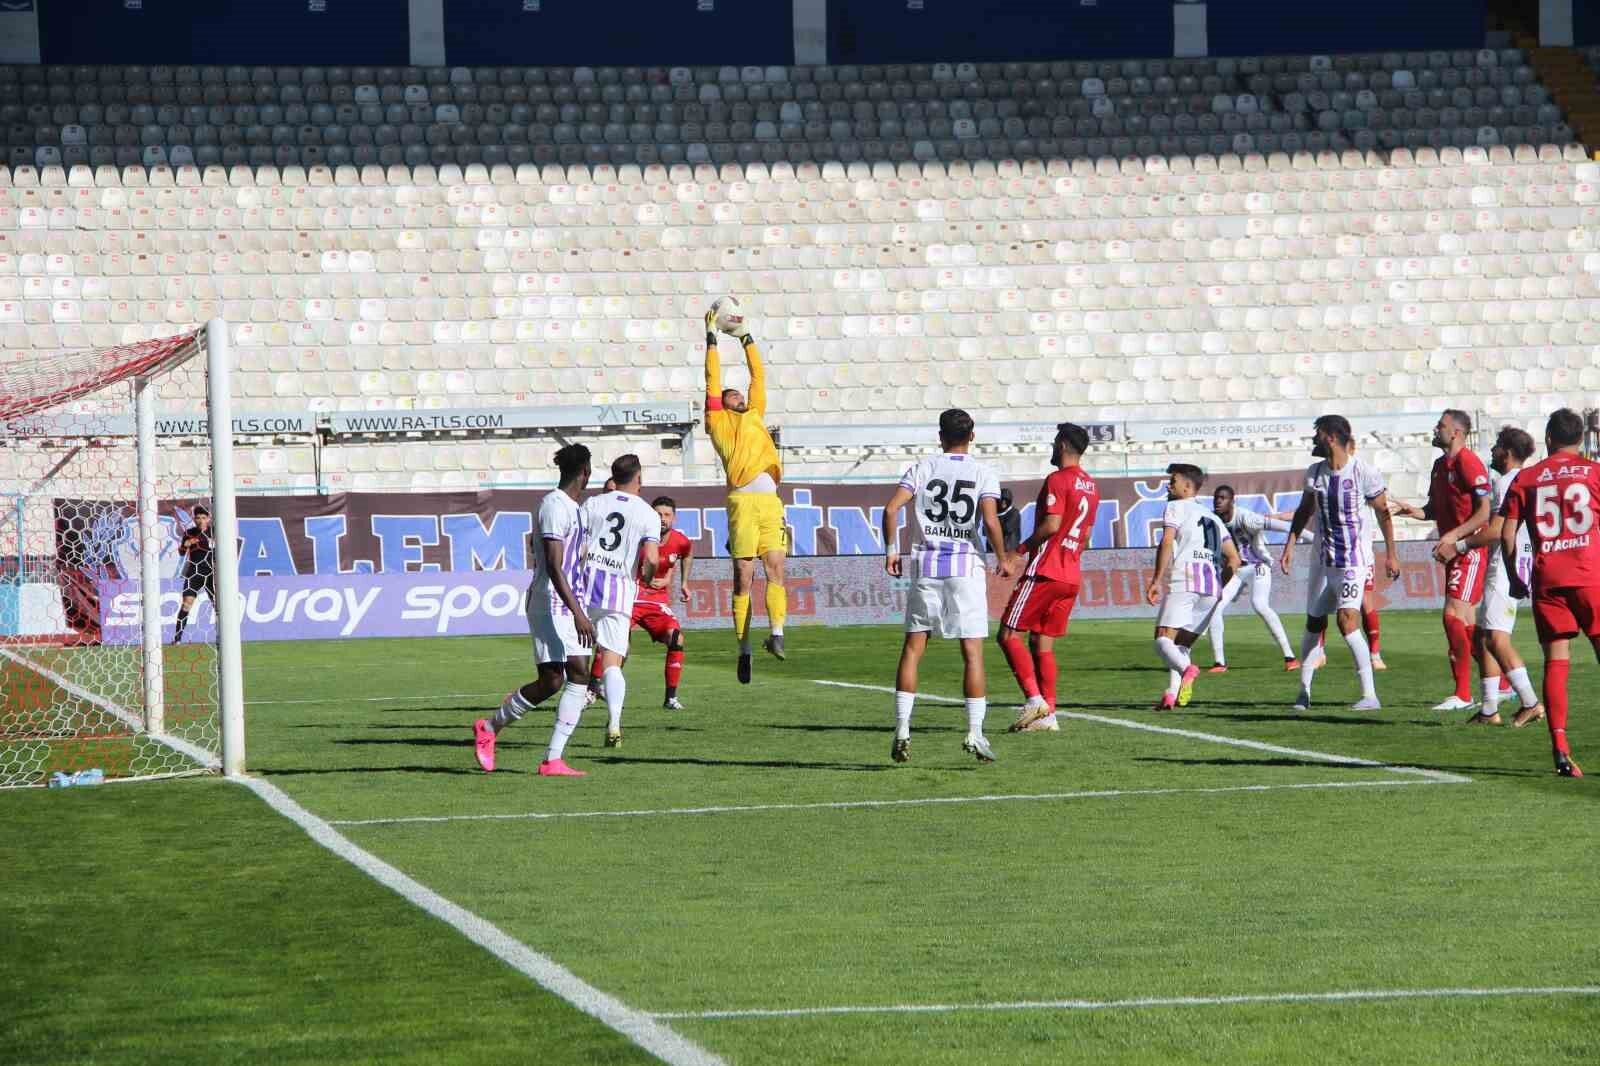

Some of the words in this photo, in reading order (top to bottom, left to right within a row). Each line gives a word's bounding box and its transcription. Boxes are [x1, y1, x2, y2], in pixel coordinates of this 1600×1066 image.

[153, 418, 302, 433] WW.RTLS.COM
[346, 414, 503, 431] WWW.RA-TLS.COM
[1162, 425, 1217, 436] GROUNDS
[1220, 424, 1242, 435] FOR
[1247, 423, 1296, 434] SUCCESS
[924, 478, 977, 525] 35
[1536, 482, 1594, 538] 53
[1067, 495, 1089, 538] 2
[598, 511, 626, 552] 3
[924, 525, 973, 539] BAHADIR
[1341, 582, 1360, 599] 36
[401, 584, 527, 633] spo
